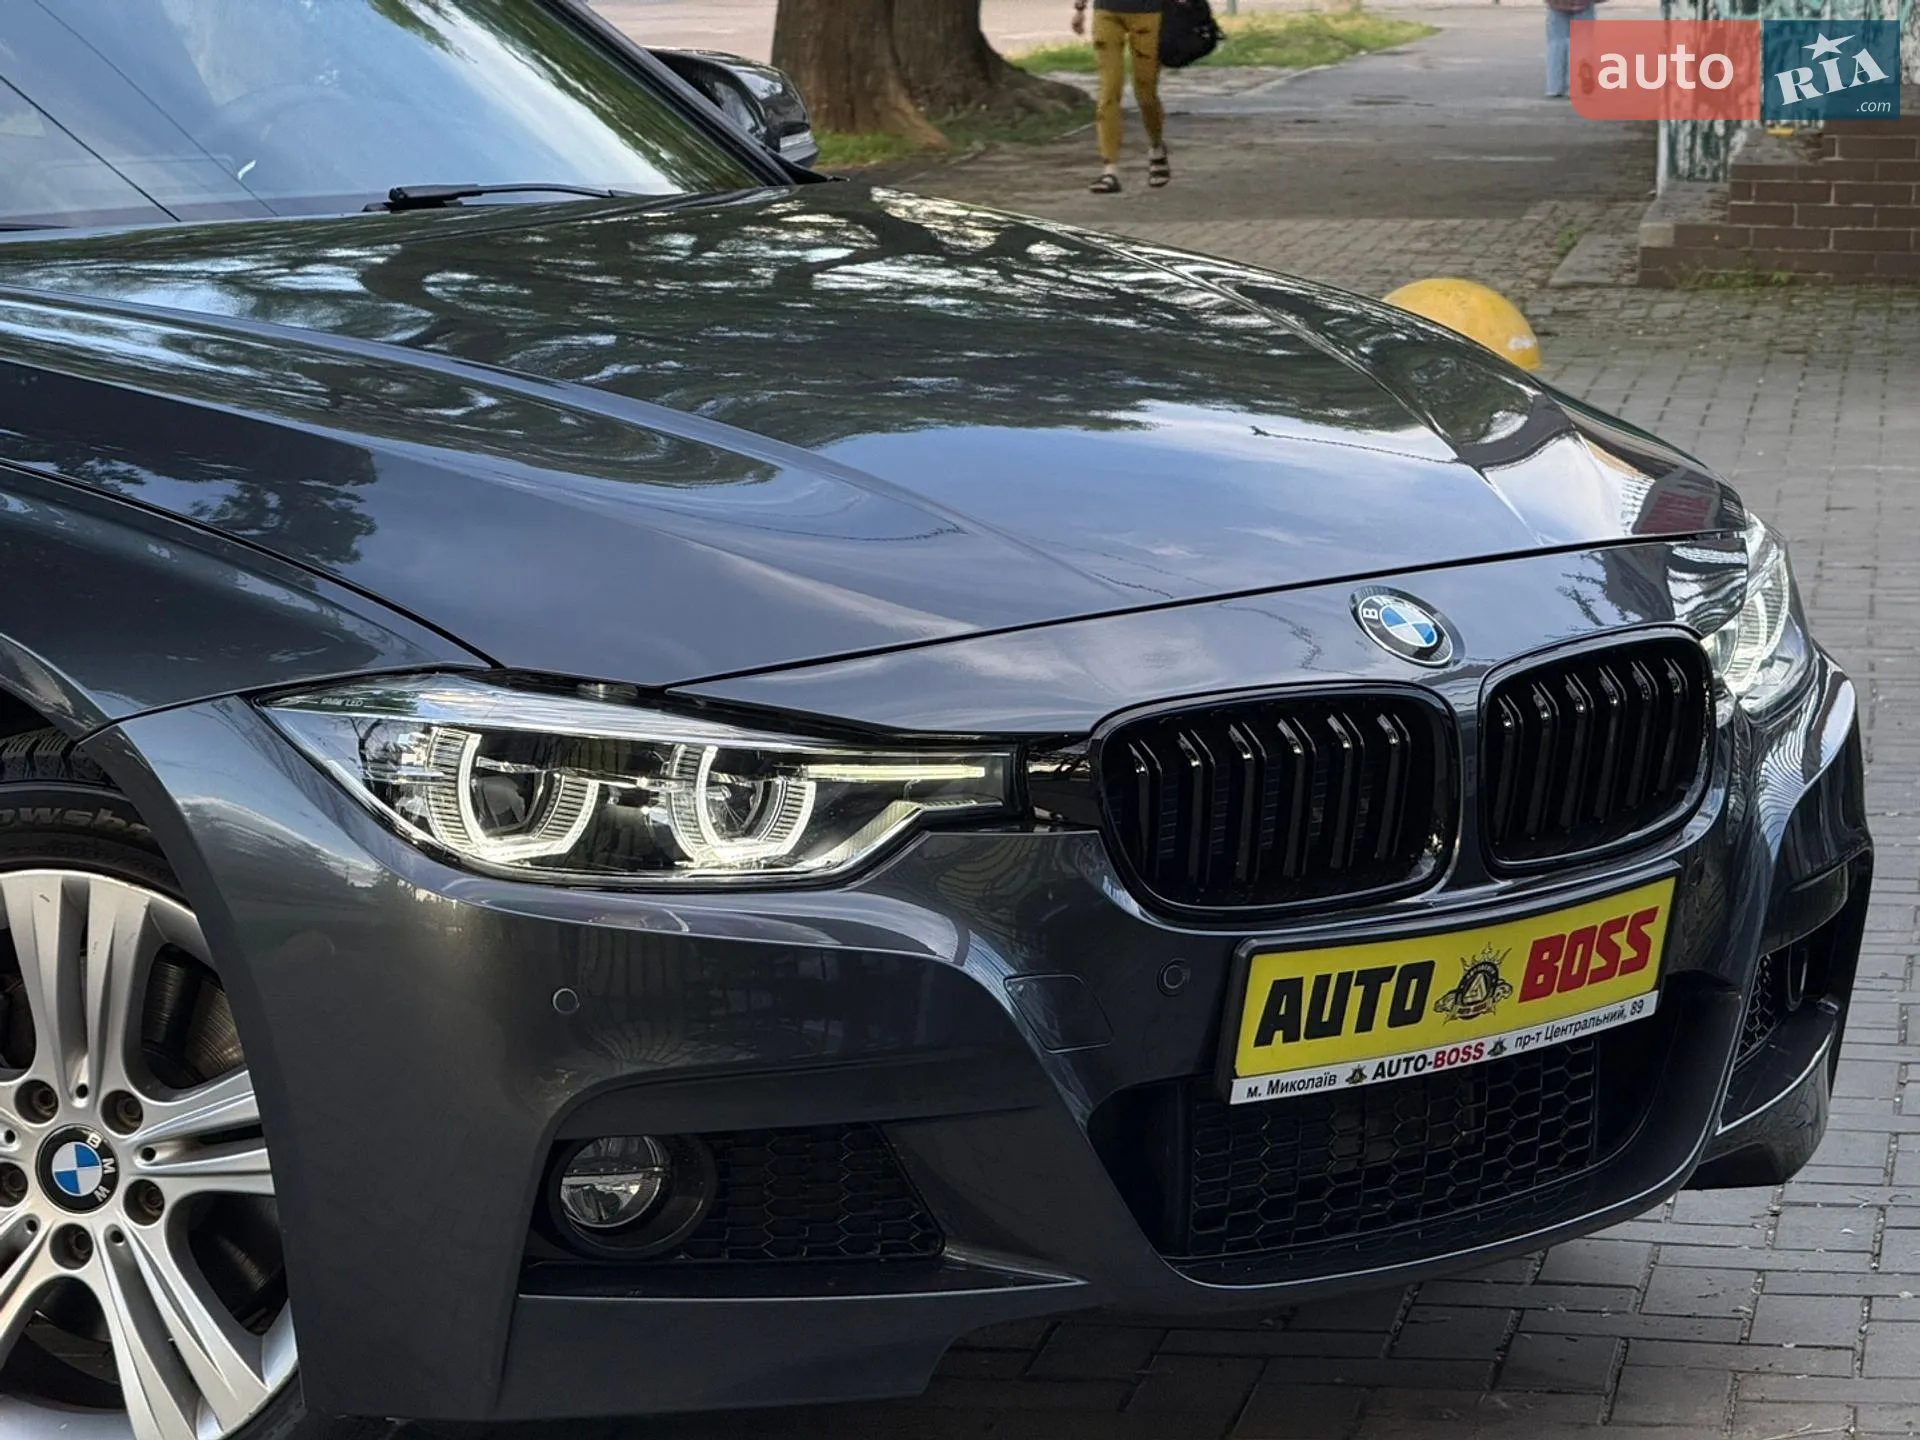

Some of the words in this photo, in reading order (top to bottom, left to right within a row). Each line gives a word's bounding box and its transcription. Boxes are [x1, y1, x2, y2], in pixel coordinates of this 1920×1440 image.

[1253, 960, 1437, 1048] AUTO
[1518, 906, 1660, 1004] BOSS
[1246, 1086, 1262, 1099] м.
[1266, 1071, 1337, 1097] Миколаїв
[1372, 1042, 1485, 1081] AUTO-BOSS
[1514, 1030, 1542, 1049] пр-т
[1543, 1005, 1628, 1042] Центральний,
[1629, 999, 1645, 1015] 89
[86, 1132, 116, 1202] BMW
